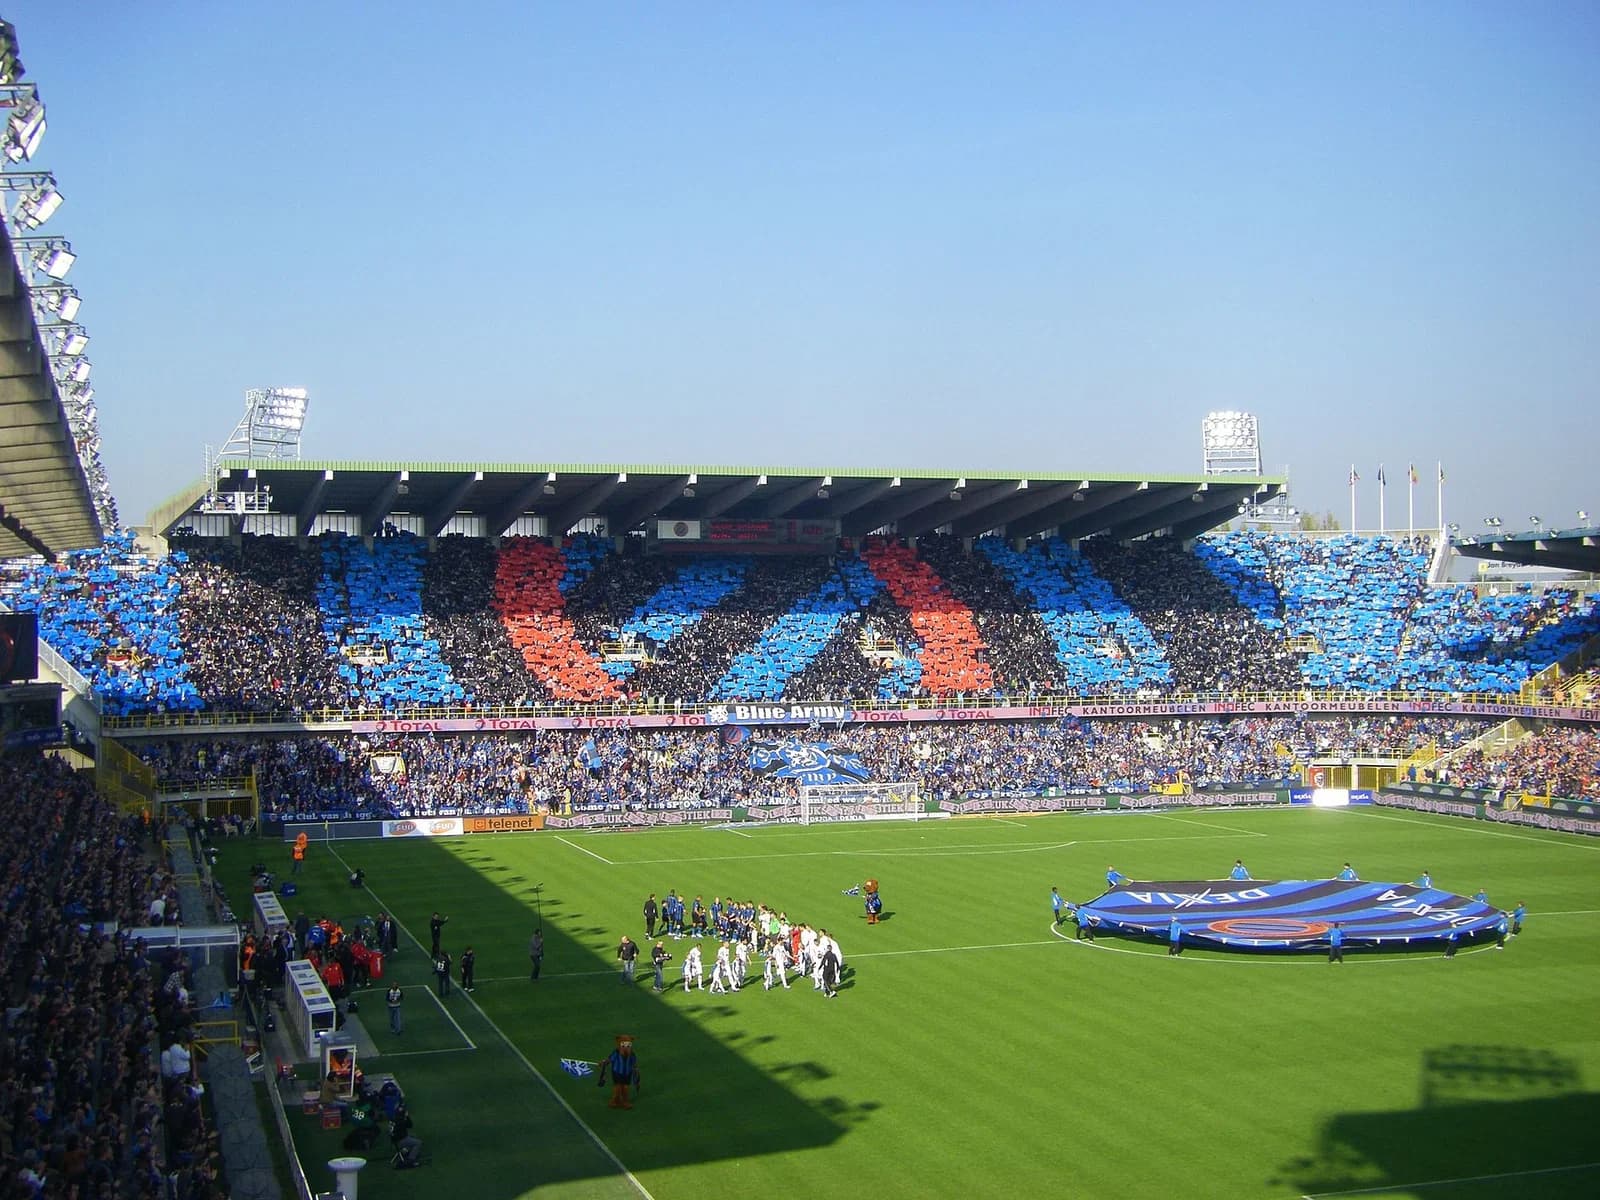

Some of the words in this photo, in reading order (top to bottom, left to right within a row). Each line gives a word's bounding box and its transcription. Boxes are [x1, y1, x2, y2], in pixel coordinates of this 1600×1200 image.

[735, 705, 785, 720] Blue
[790, 703, 845, 720] Army
[1083, 704, 1206, 715] KANTOORMEUBELEN
[1265, 702, 1400, 712] KANTOORMEUBELEN
[1462, 704, 1561, 718] KANTOORMEUBELEN
[861, 711, 909, 722] TOTAL
[950, 708, 994, 720] TOTAL
[390, 720, 443, 732] TOTAL
[488, 719, 537, 730] TOTAL
[586, 717, 637, 728] TOTAL
[488, 818, 533, 829] telenet
[1126, 887, 1271, 910] DEXIA
